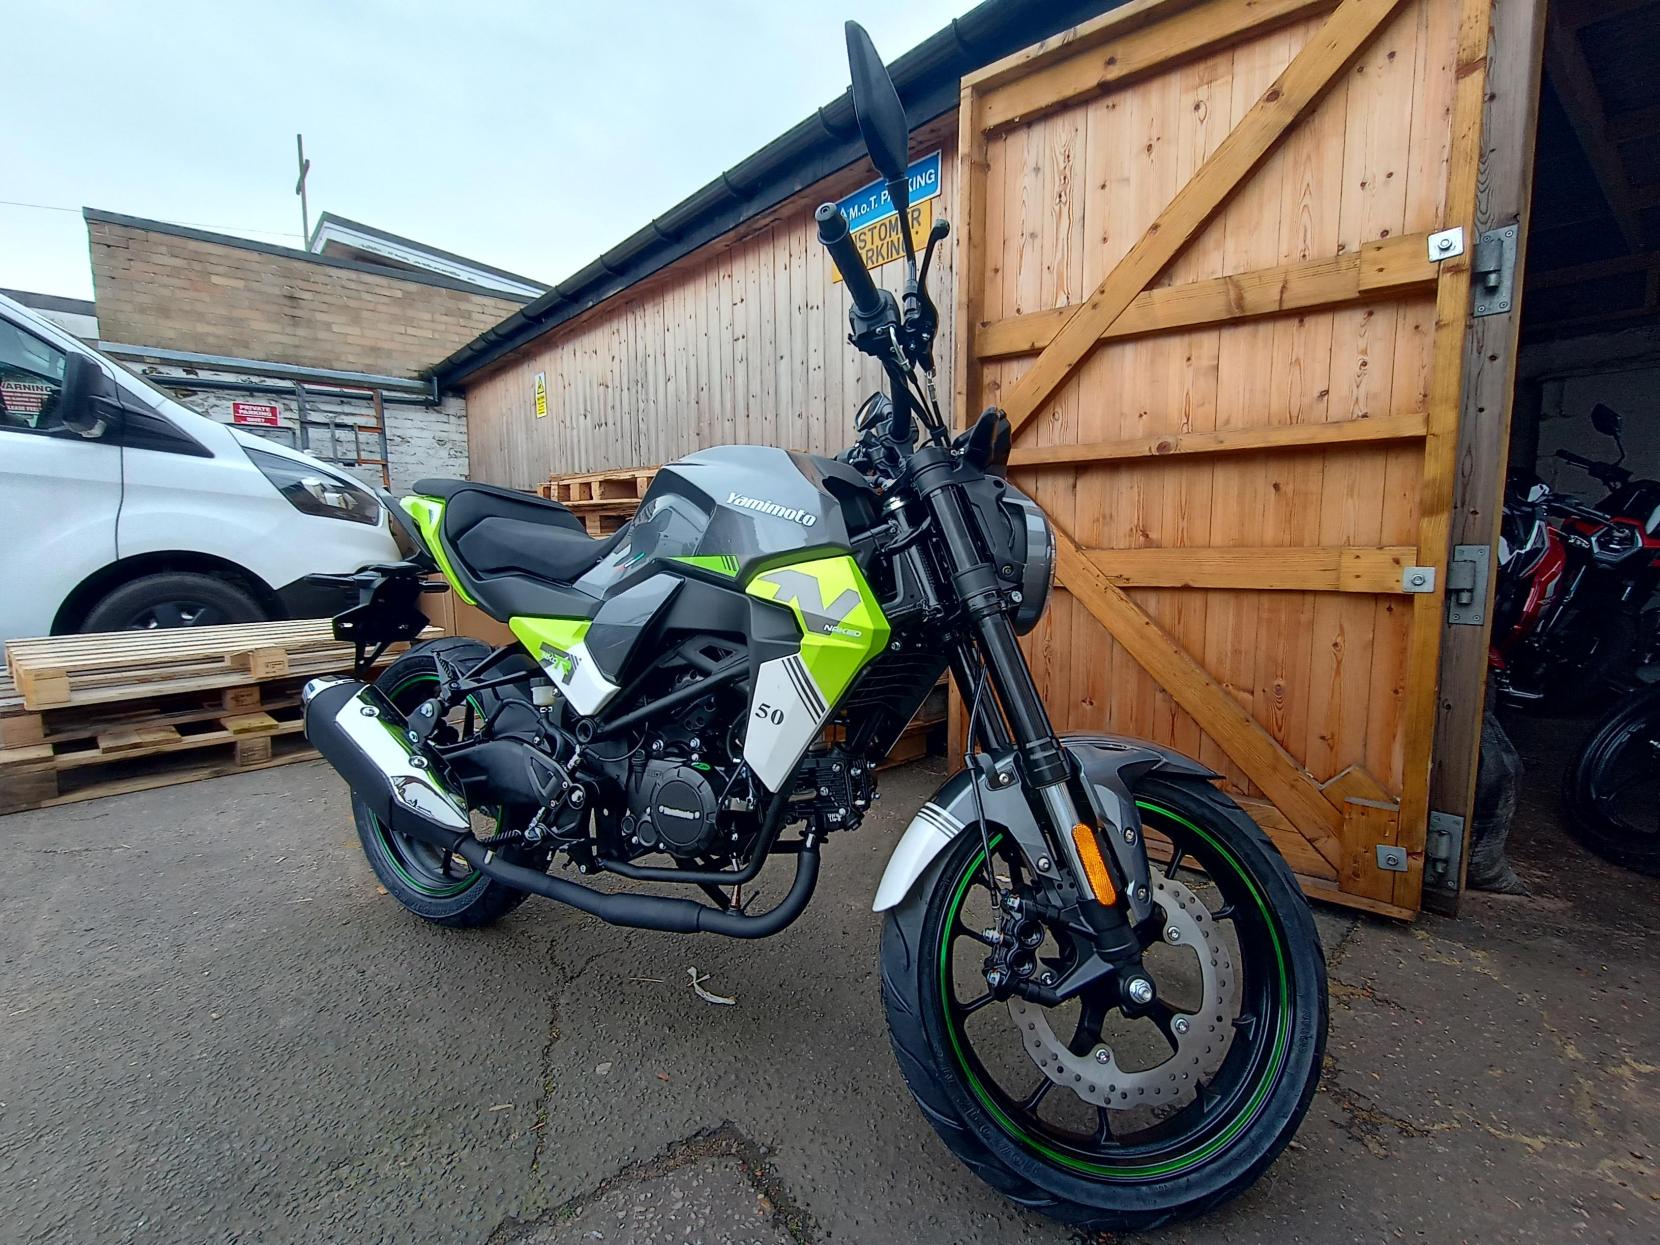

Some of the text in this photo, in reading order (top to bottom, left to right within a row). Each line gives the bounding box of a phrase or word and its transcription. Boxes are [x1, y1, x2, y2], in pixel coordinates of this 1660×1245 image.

[881, 169, 936, 204] PKING
[238, 409, 272, 417] PARKING
[239, 404, 271, 413] PRIVATE
[726, 491, 817, 527] Yamimoto
[755, 703, 784, 725] 50
